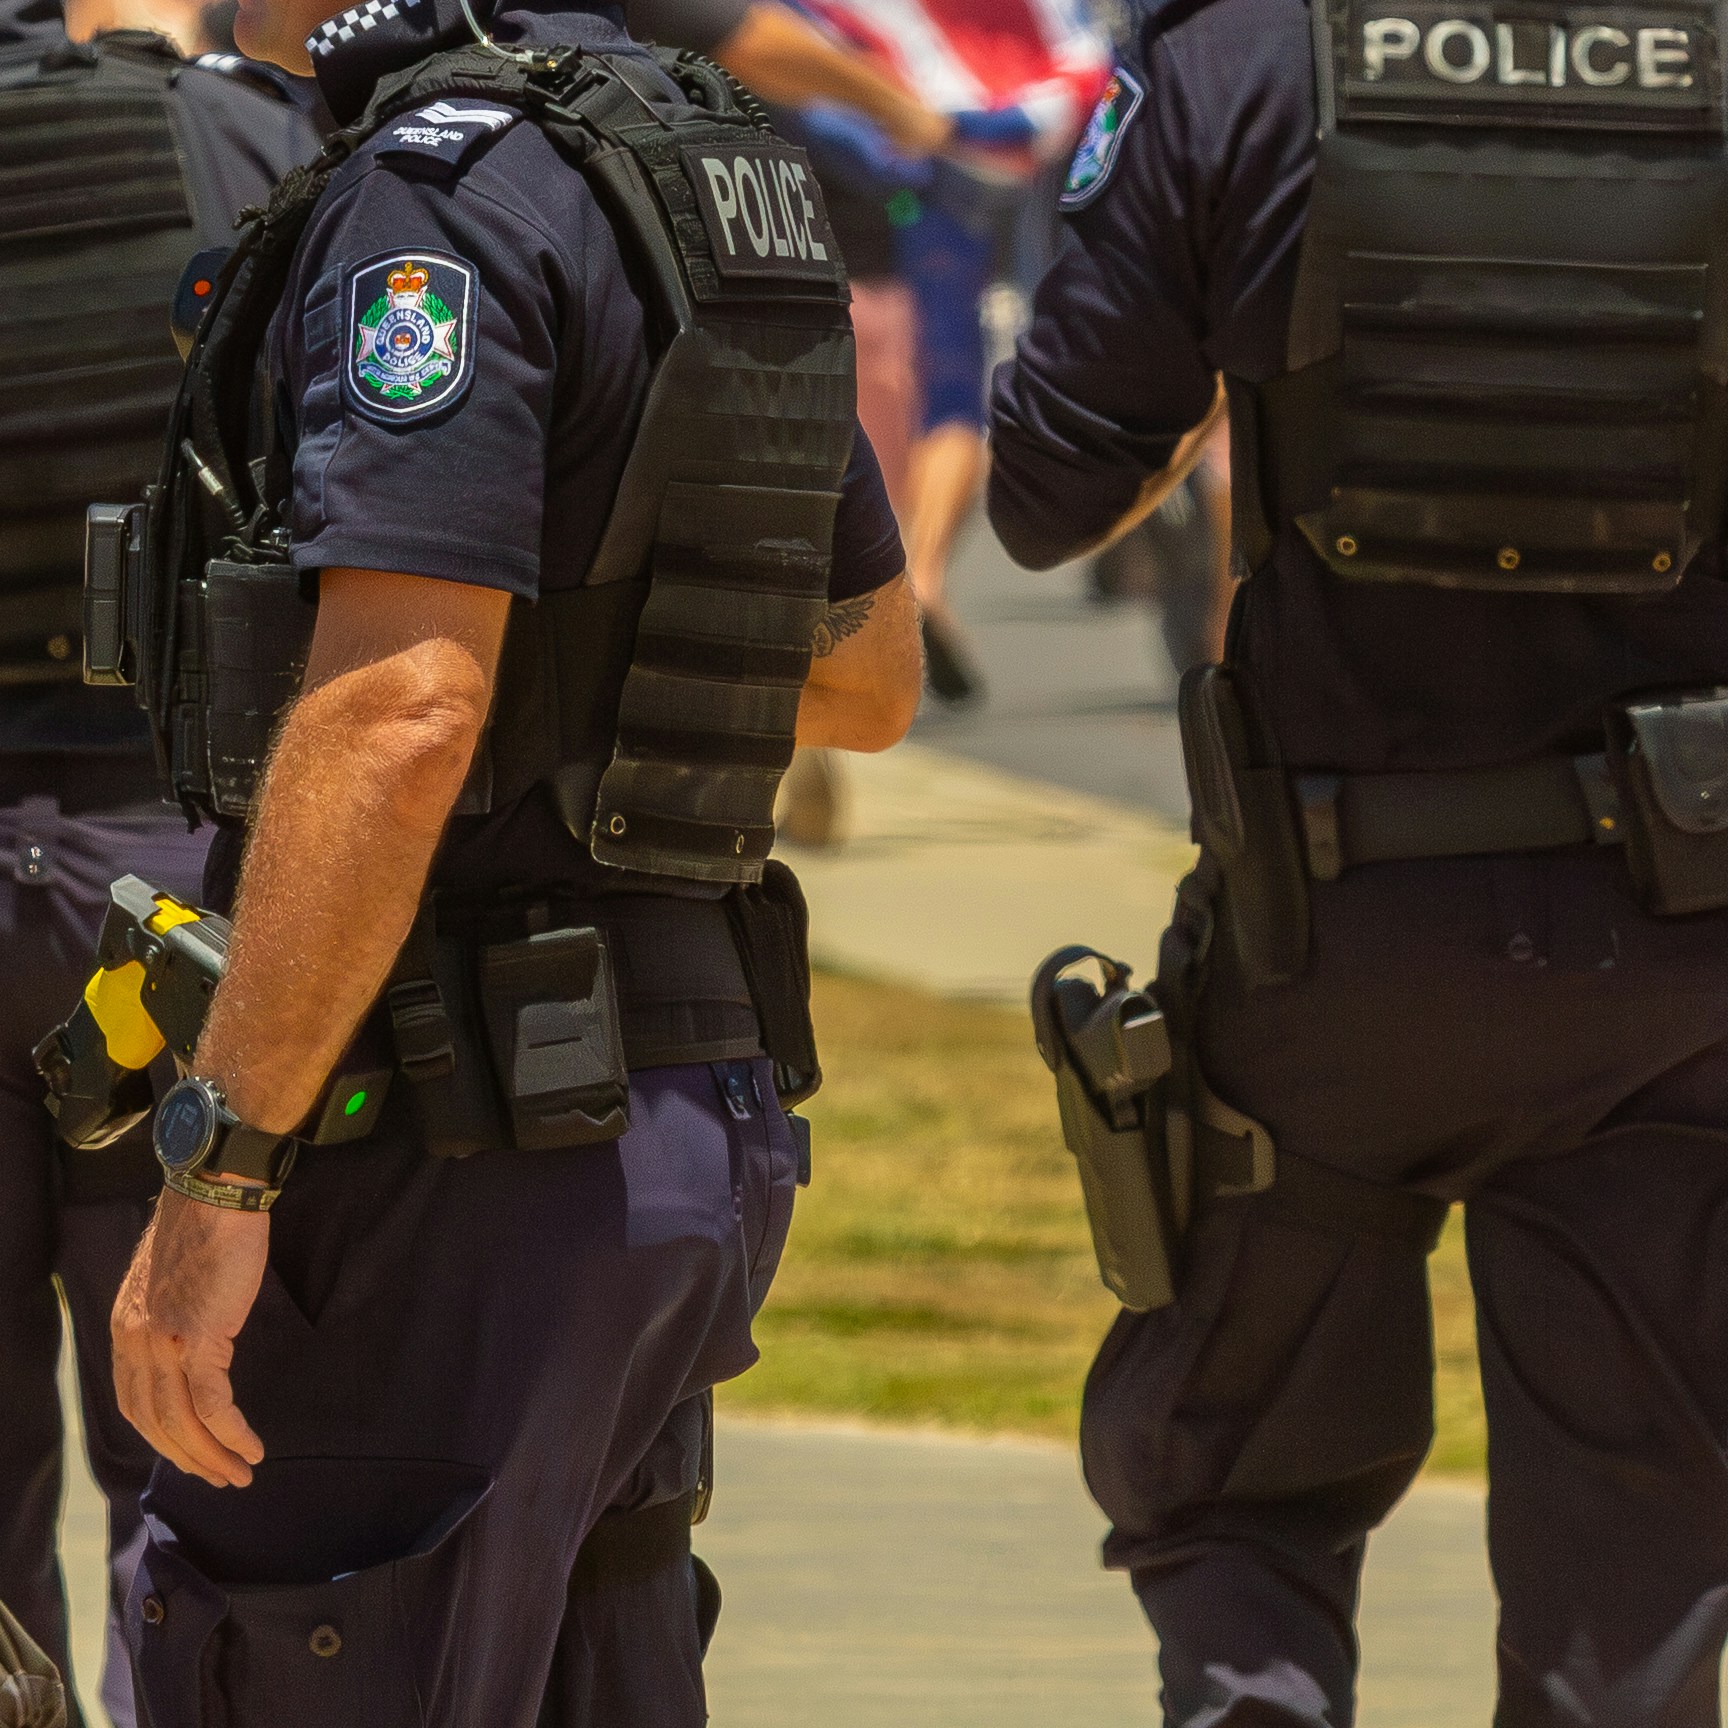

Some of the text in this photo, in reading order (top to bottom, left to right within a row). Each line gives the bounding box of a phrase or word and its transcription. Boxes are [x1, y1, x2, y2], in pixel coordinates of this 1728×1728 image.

[1363, 18, 1693, 88] POLICE
[701, 156, 828, 261] POLICE
[376, 308, 431, 345] QUEENSLAND
[382, 352, 424, 368] POLICE
